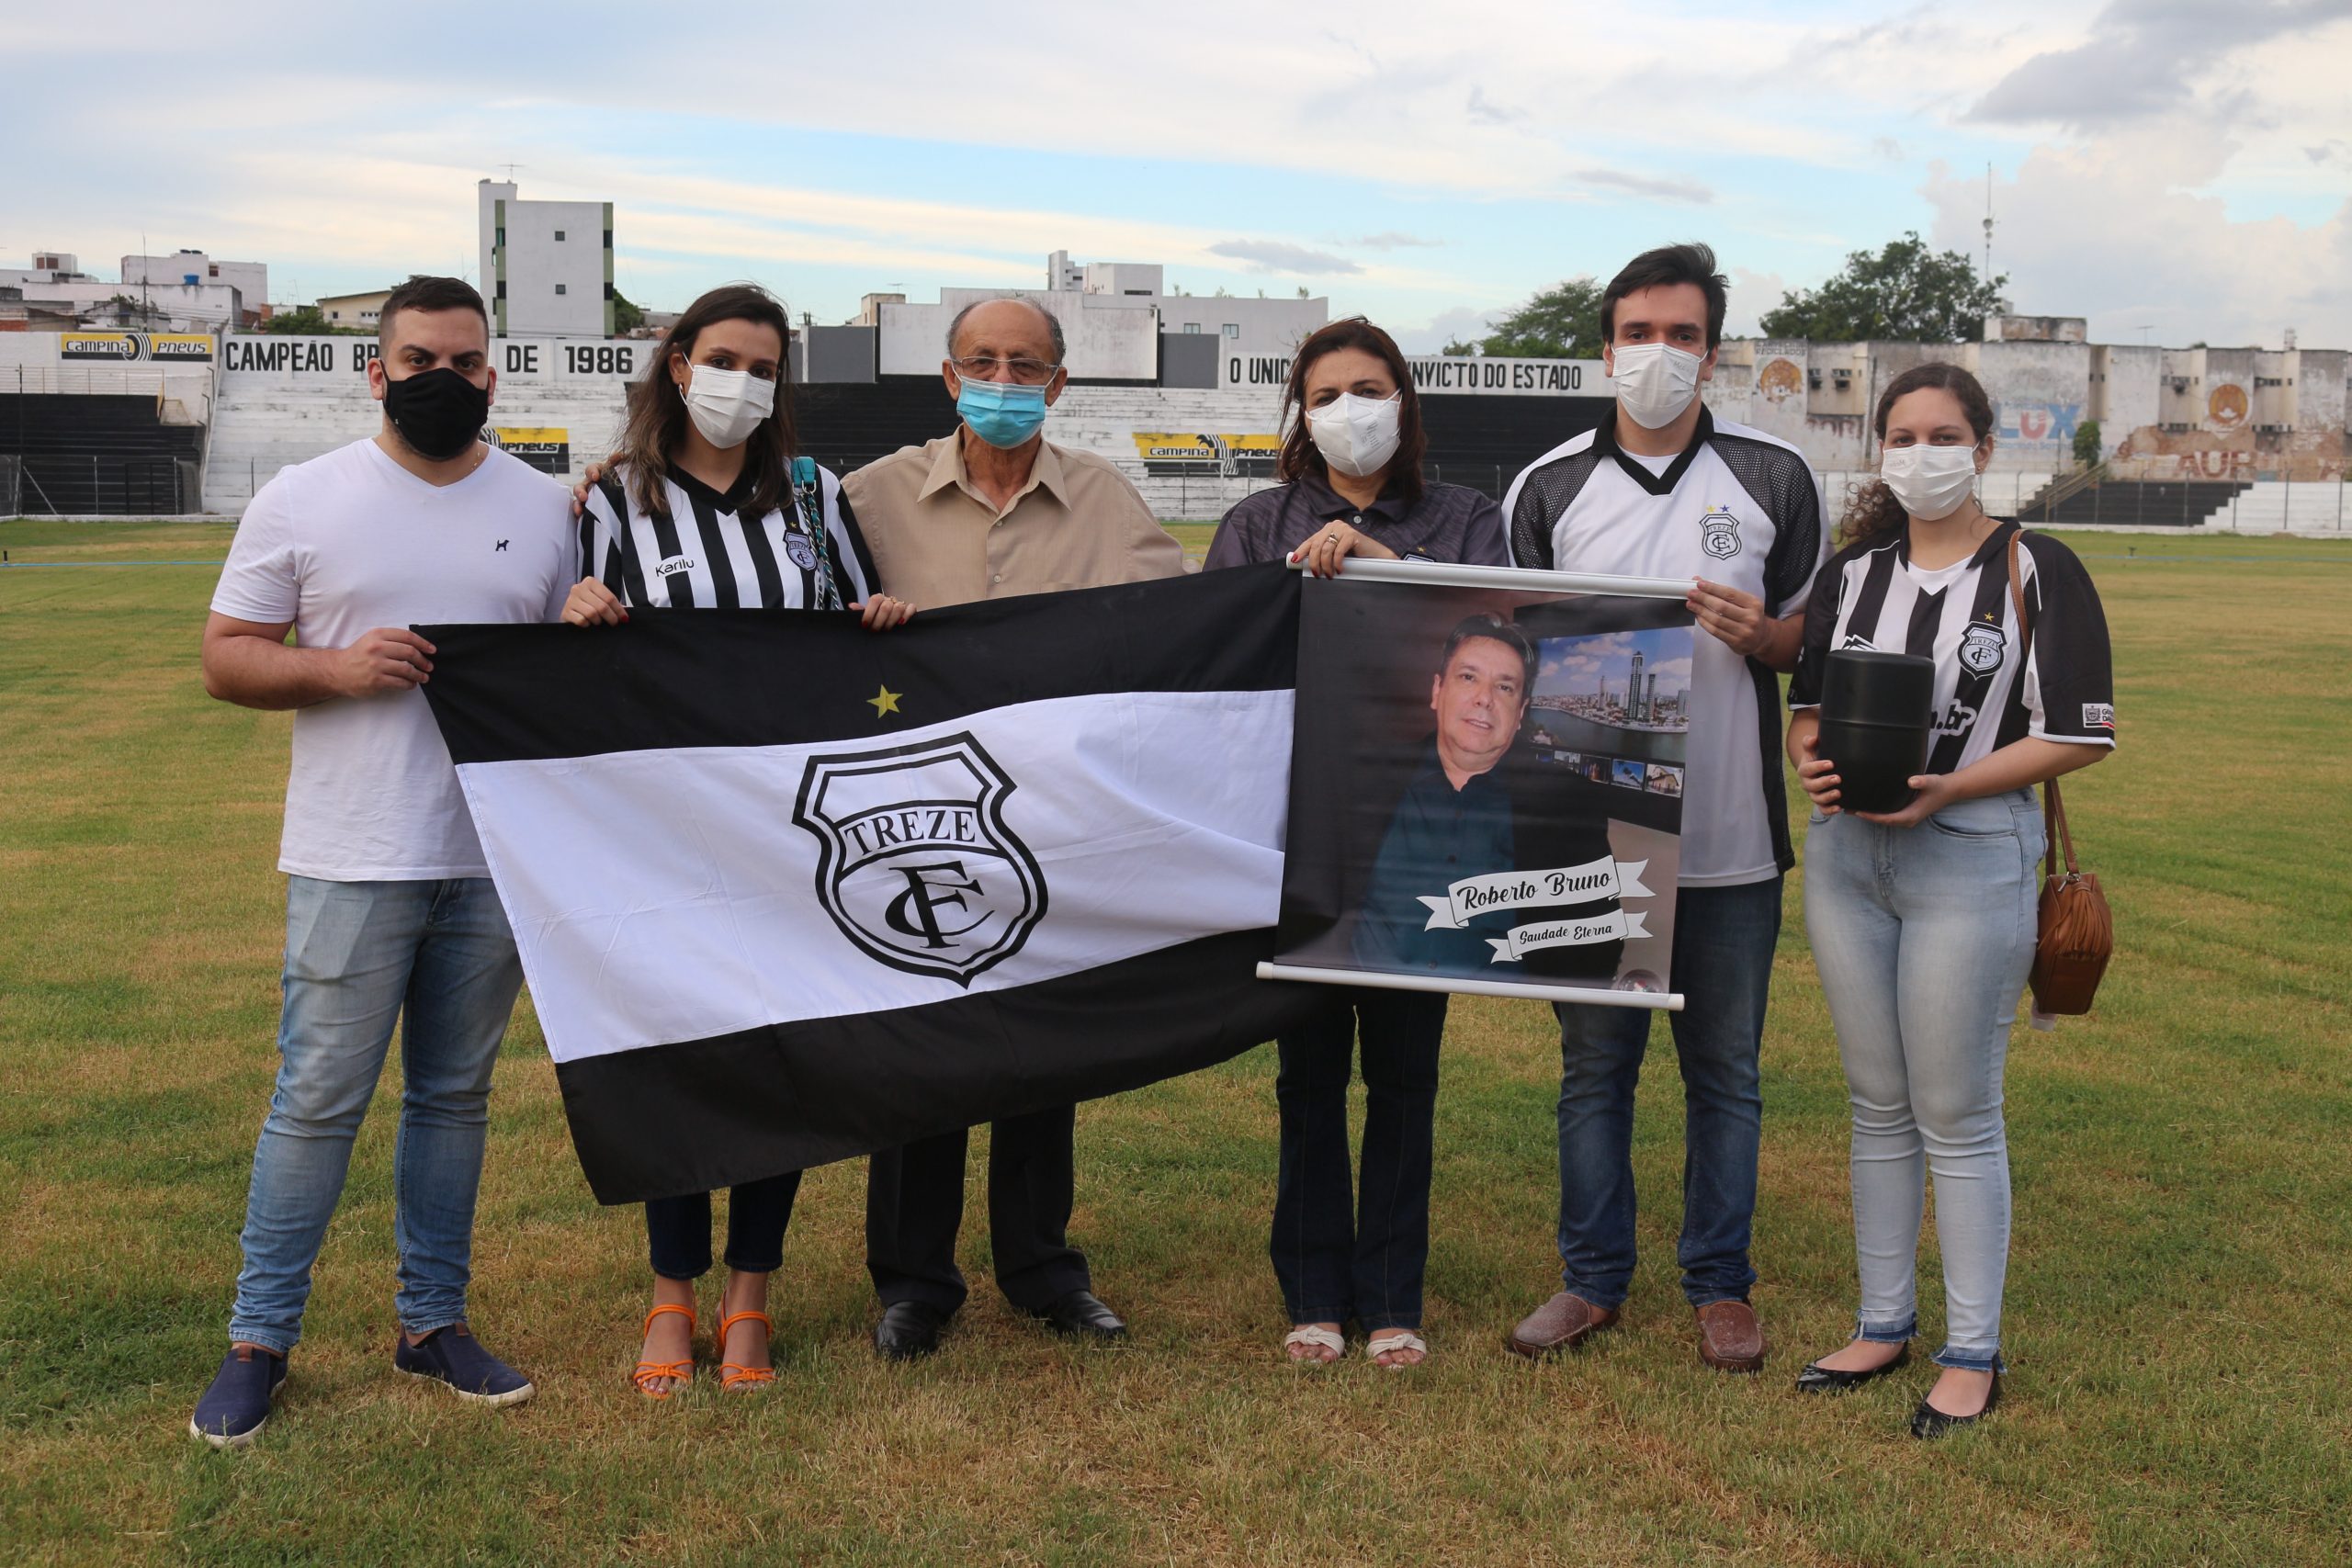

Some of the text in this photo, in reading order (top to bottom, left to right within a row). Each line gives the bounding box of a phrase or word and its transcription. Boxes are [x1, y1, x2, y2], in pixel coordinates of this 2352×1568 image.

[157, 343, 206, 353] Pneus
[226, 340, 334, 372] CAMPEÃO
[506, 345, 538, 373] DE
[565, 346, 633, 374] 1986
[1230, 357, 1241, 384] O
[1409, 362, 1478, 388] NVICTO
[1484, 364, 1507, 388] DO
[1513, 365, 1581, 390] ESTADO
[655, 558, 695, 577] Karilu
[843, 808, 977, 857] TREZE
[1456, 872, 1611, 910] Roberto Bruno
[1519, 924, 1613, 945] Saudade Eterna
